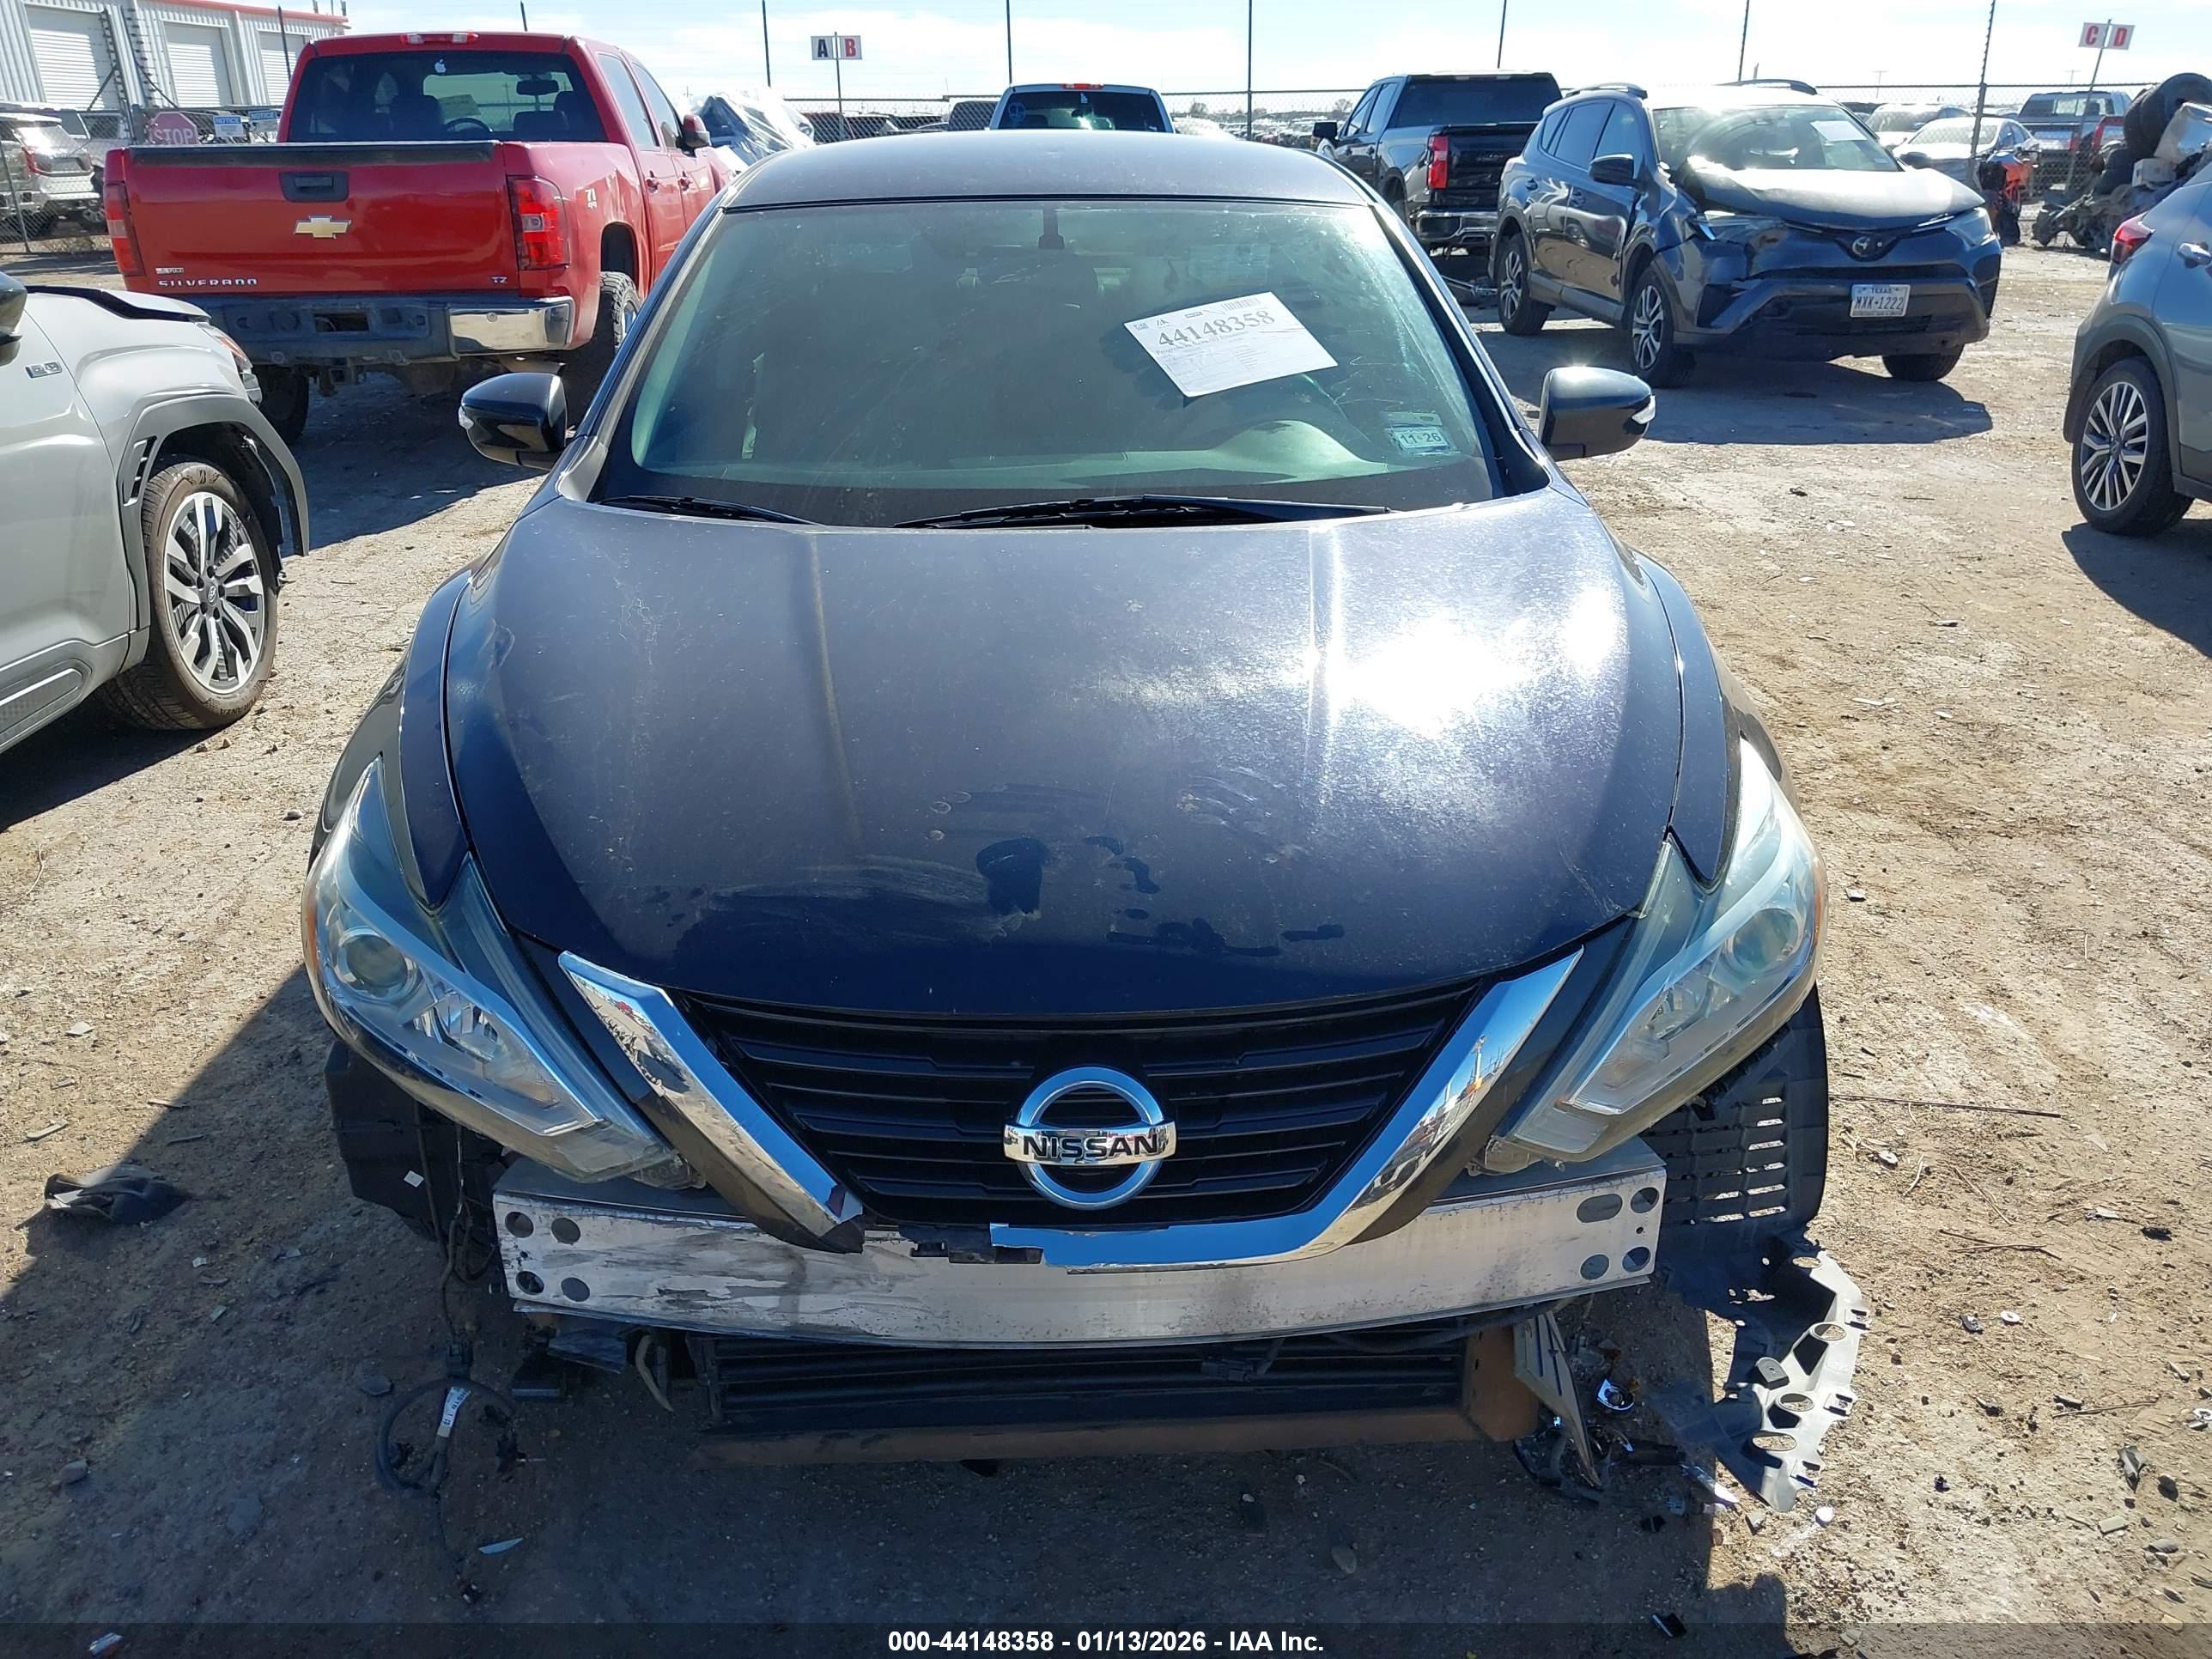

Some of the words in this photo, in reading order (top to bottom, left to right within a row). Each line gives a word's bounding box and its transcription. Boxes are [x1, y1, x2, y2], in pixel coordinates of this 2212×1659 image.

[2085, 25, 2099, 46] C
[2112, 27, 2128, 46] D
[817, 39, 829, 58] A
[844, 38, 857, 58] B
[157, 128, 193, 144] STOP
[157, 277, 258, 288] SILVERADO
[1158, 310, 1275, 347] 44148358
[1023, 1133, 1157, 1158] NISSAN
